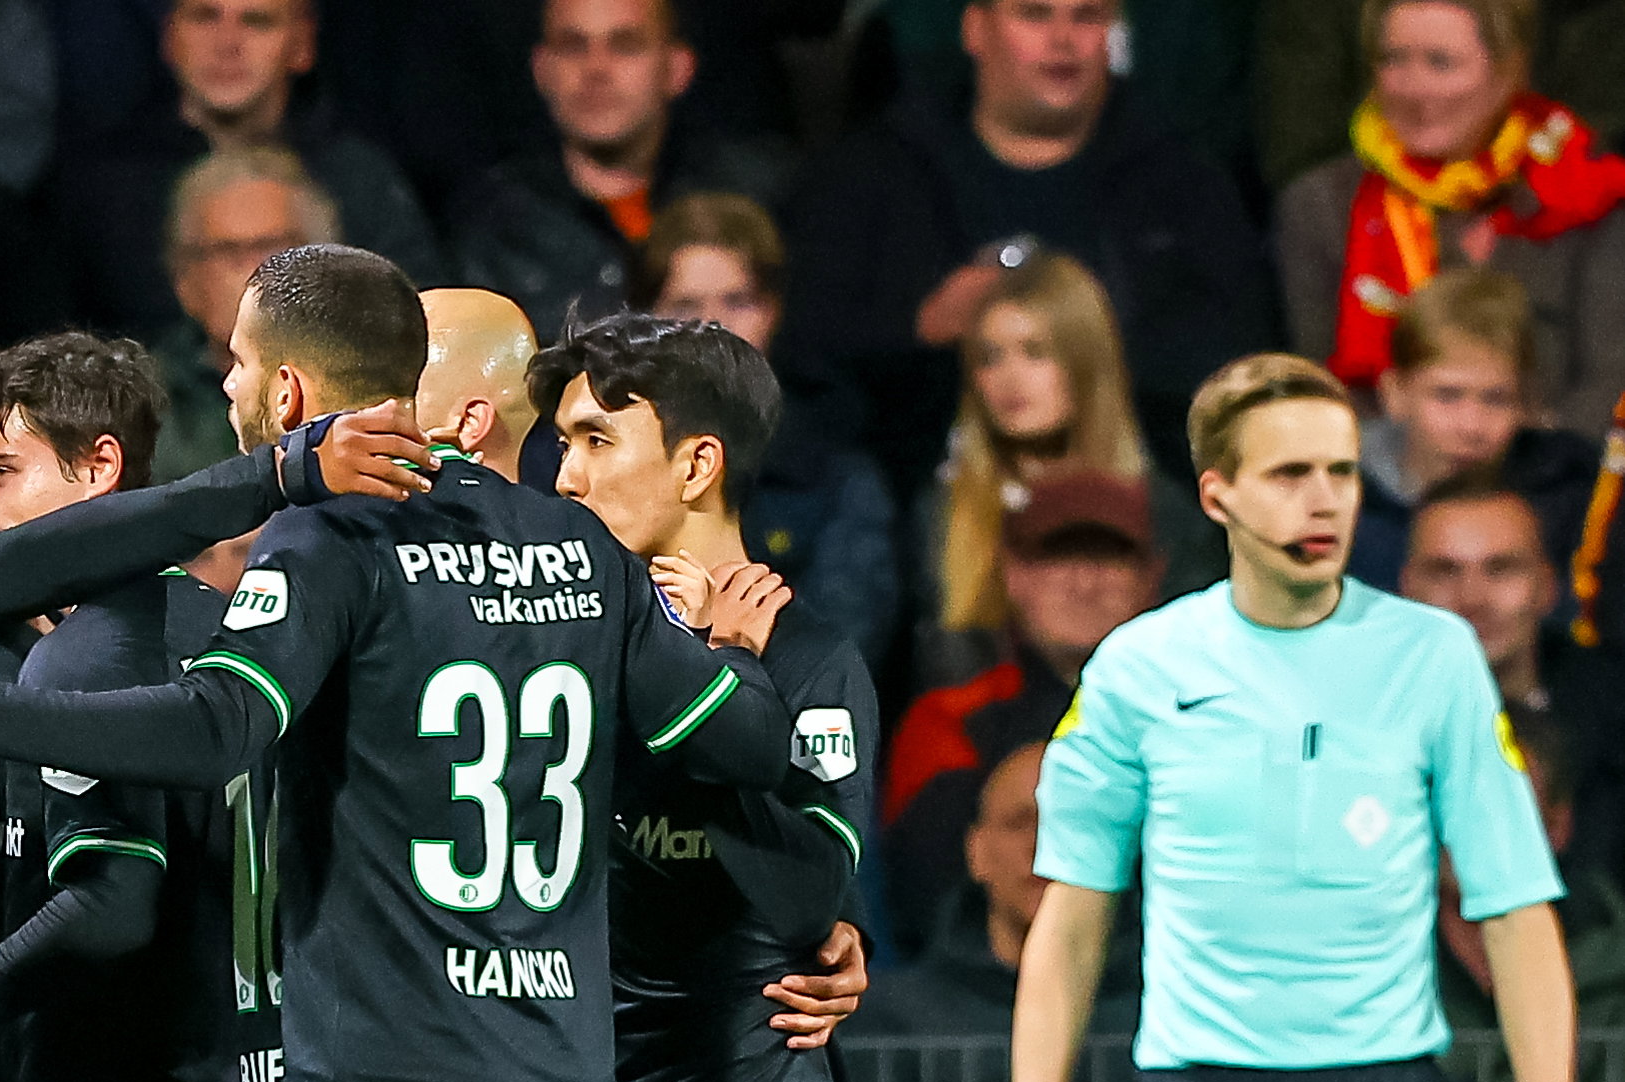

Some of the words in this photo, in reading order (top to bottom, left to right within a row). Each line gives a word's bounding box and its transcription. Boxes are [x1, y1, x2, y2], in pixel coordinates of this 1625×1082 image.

[469, 586, 603, 624] vakanties
[796, 732, 851, 758] TOTO
[411, 661, 593, 913] 33
[446, 946, 575, 998] HANCKO
